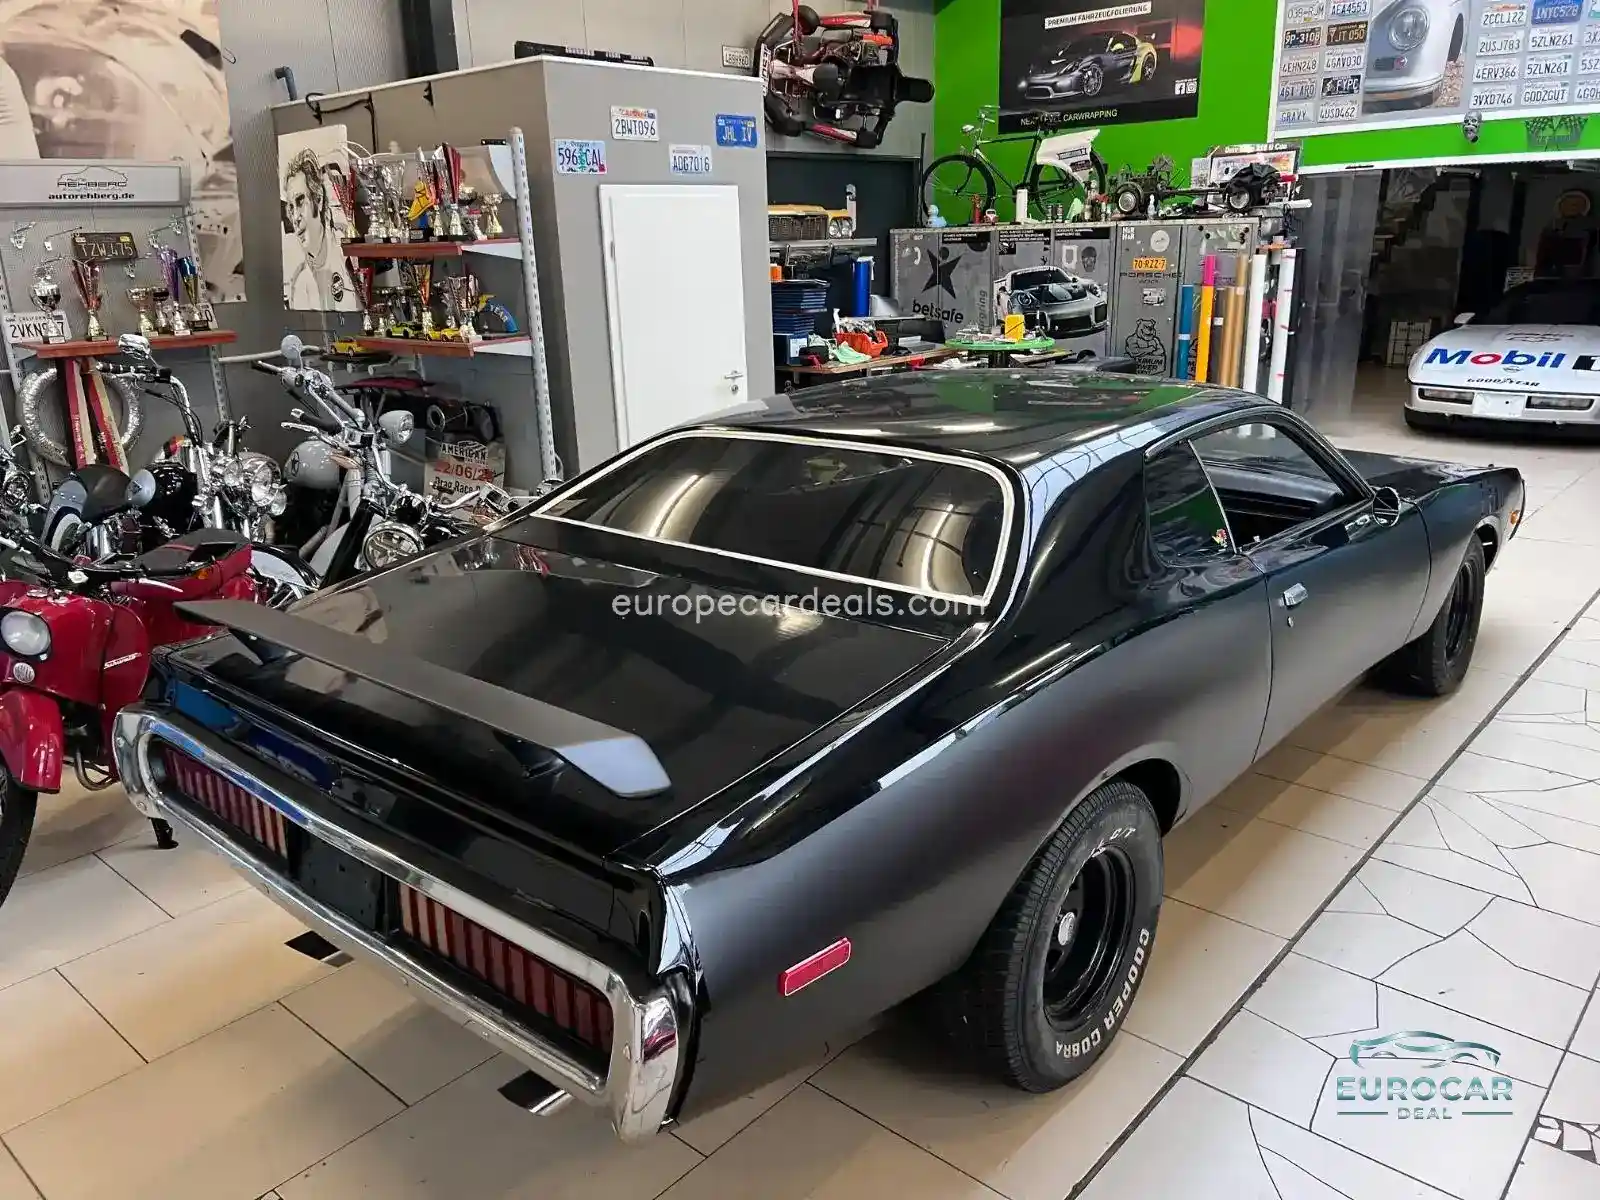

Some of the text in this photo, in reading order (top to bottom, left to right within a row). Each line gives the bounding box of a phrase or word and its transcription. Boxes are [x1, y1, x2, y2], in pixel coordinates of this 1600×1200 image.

[1047, 15, 1076, 27] PREMIUM
[1063, 109, 1118, 122] CARWRAPPING
[558, 148, 578, 166] 596
[48, 192, 135, 201] autorehberg.de
[912, 299, 964, 324] betsafe
[1423, 347, 1567, 369] Mobil
[441, 443, 487, 460] AMERICAN
[1104, 927, 1150, 1031] COOPER
[1055, 1034, 1101, 1059] COBRA
